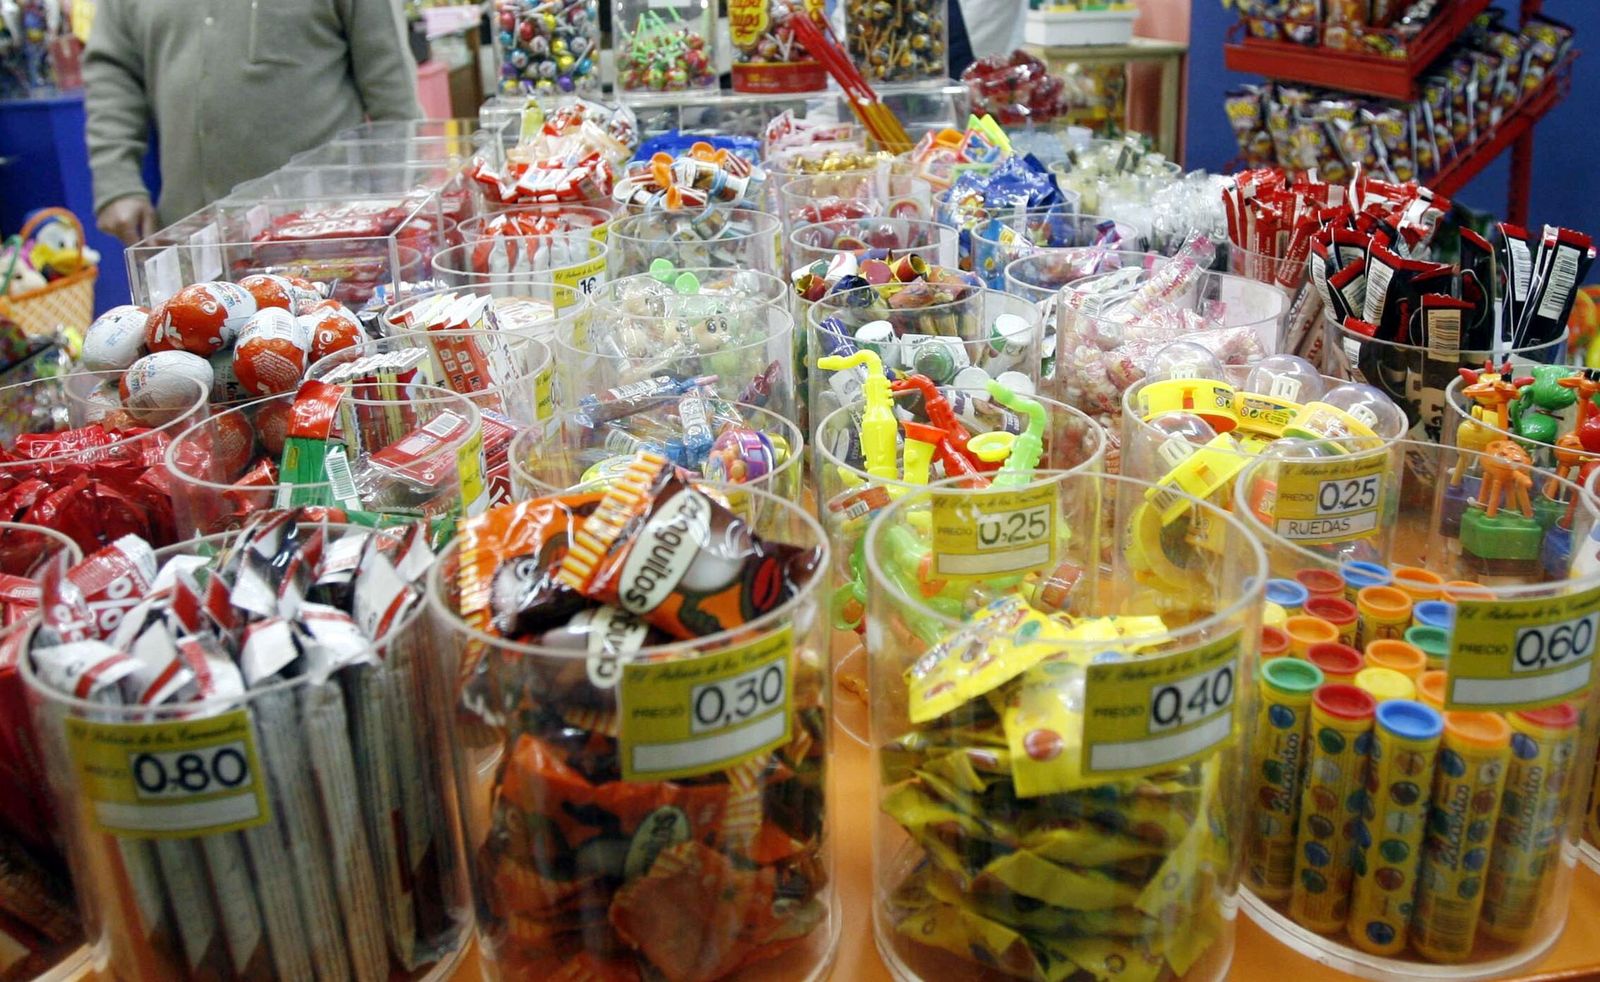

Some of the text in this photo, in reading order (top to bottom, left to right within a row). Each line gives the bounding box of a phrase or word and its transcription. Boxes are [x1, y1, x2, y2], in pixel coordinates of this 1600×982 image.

[1281, 492, 1315, 502] PRECIO
[936, 527, 973, 536] PRECIO
[1288, 518, 1351, 535] RUEDAS
[1458, 643, 1508, 655] PRECIO
[1516, 618, 1592, 668] 0,60
[695, 665, 782, 727] 0,30
[1152, 667, 1233, 726] 0,40
